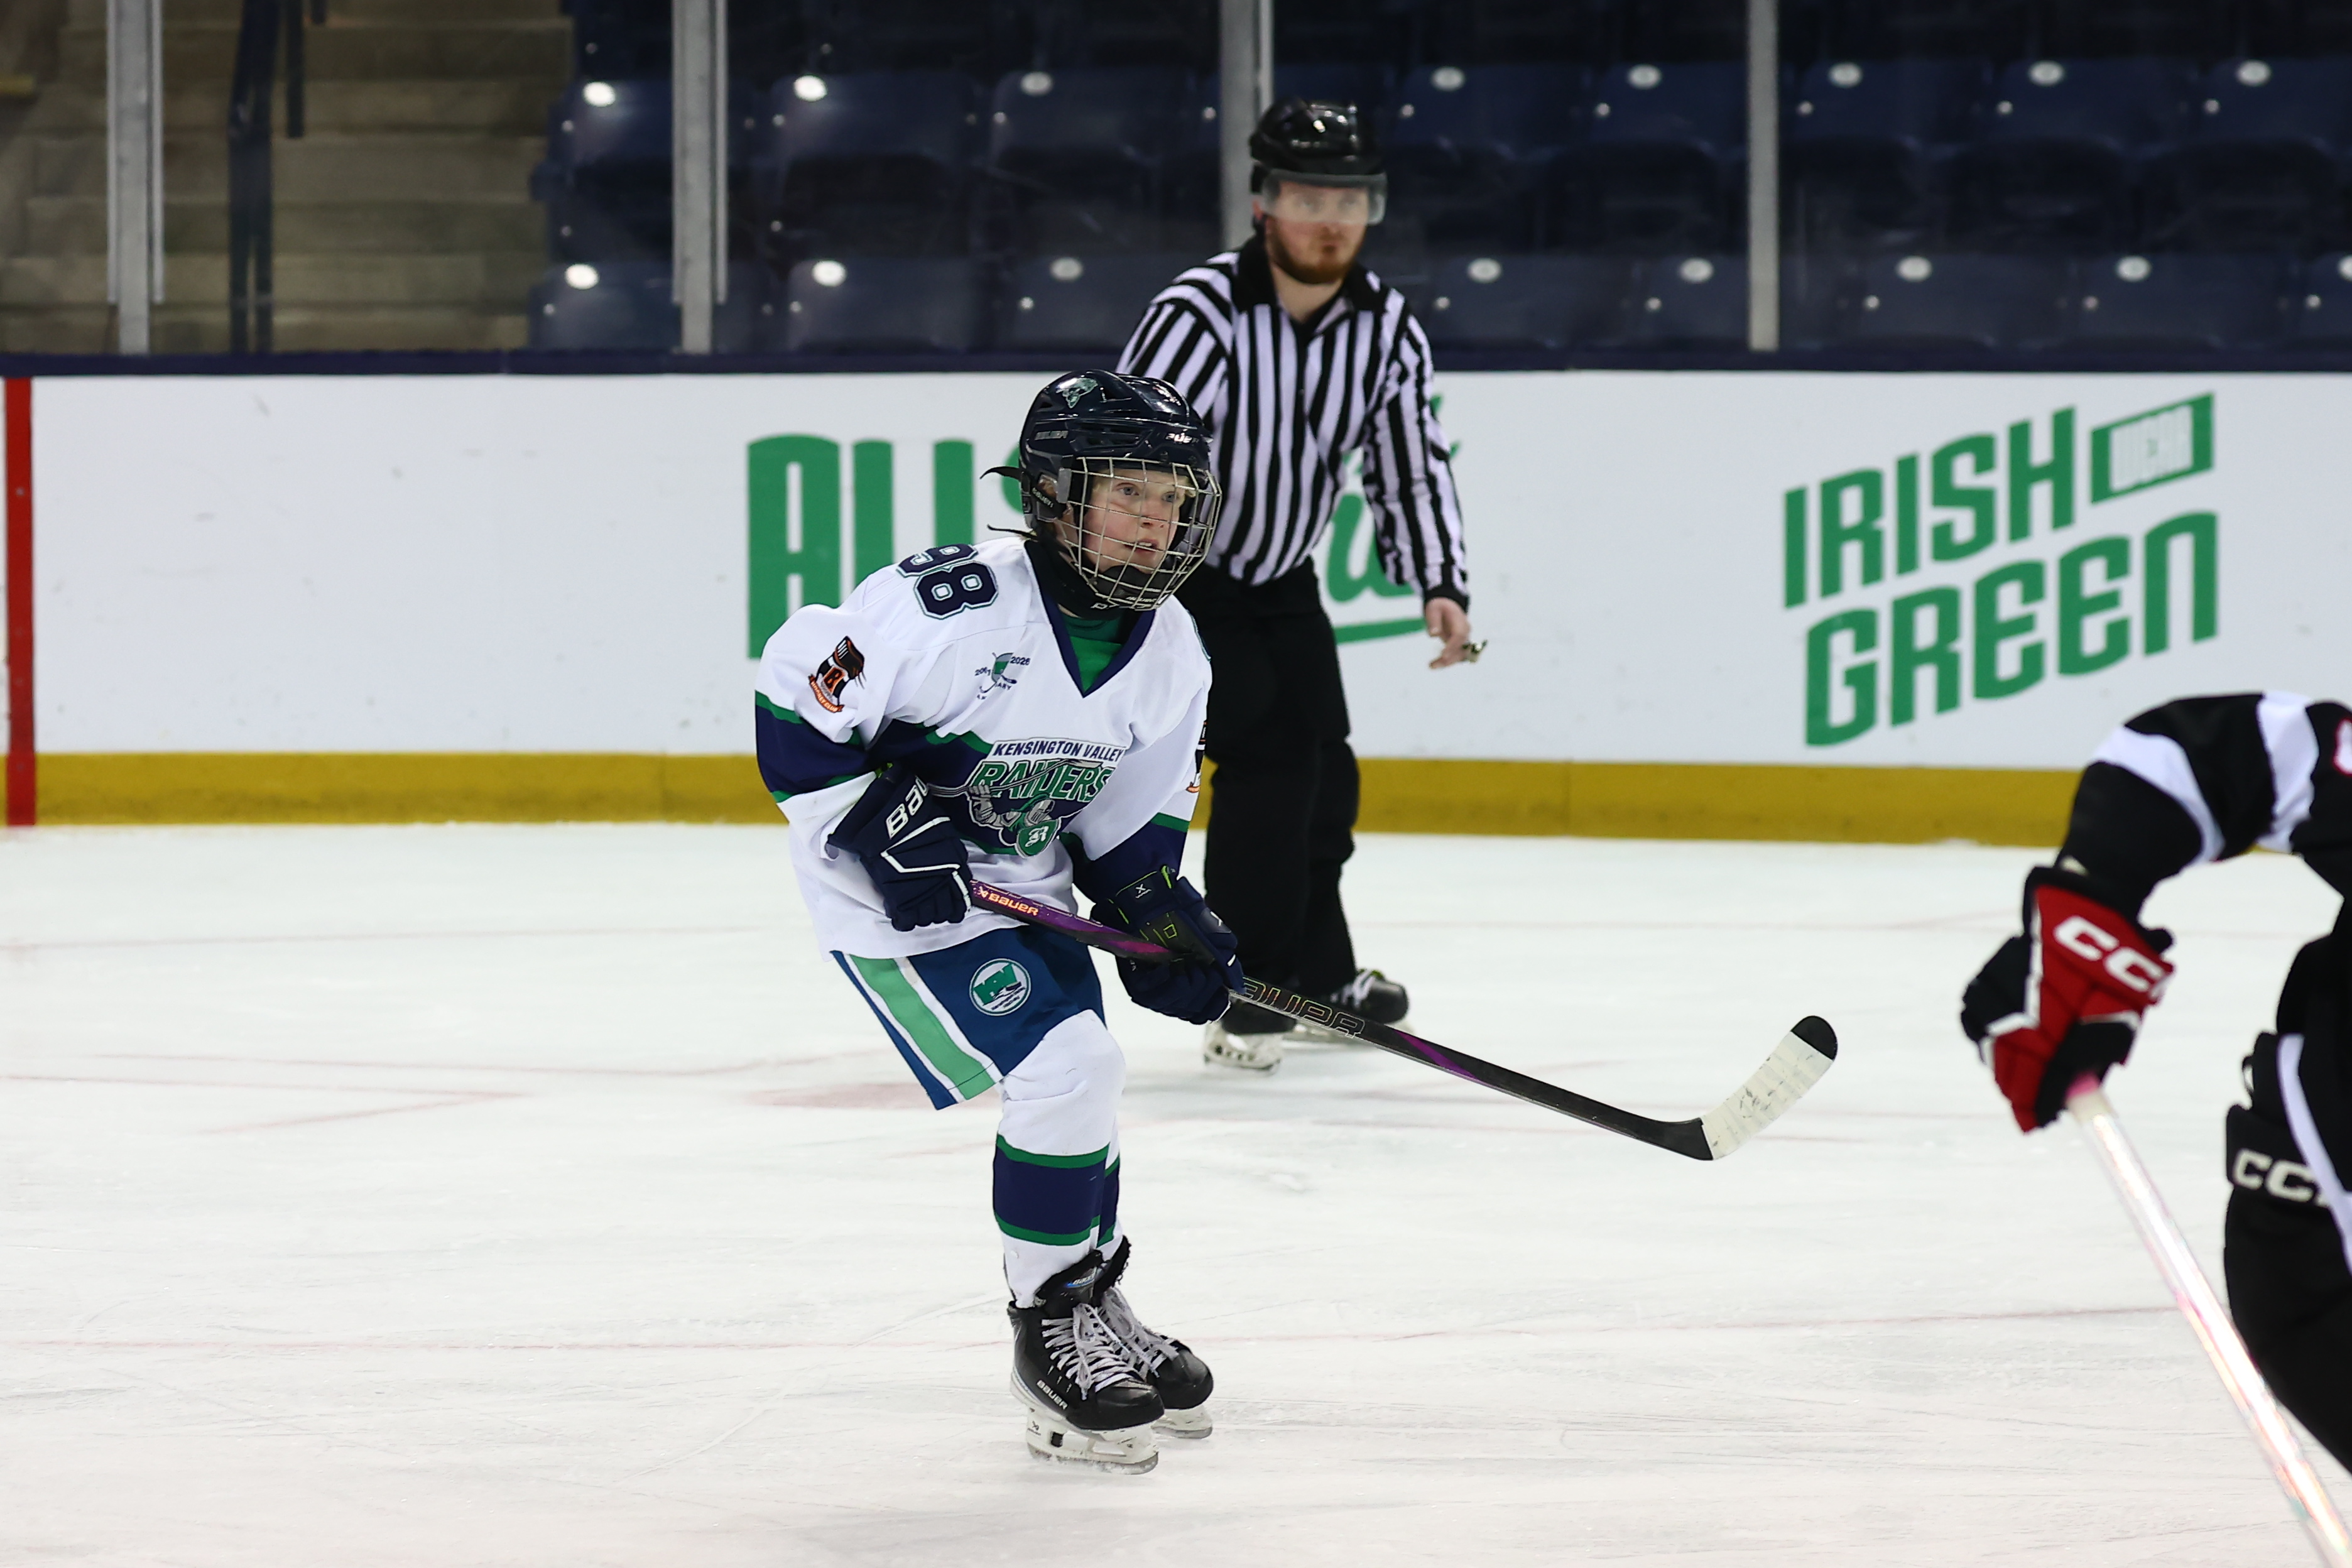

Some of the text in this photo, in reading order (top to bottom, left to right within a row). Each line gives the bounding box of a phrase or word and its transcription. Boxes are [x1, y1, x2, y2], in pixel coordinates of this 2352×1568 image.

[1784, 406, 2076, 609] IRISH
[896, 543, 999, 620] 98
[1805, 511, 2218, 746] GREEN
[967, 759, 1117, 803] RAIDERS
[993, 740, 1124, 762] KENSINGTON VALLEY
[1243, 977, 1365, 1038] AUER
